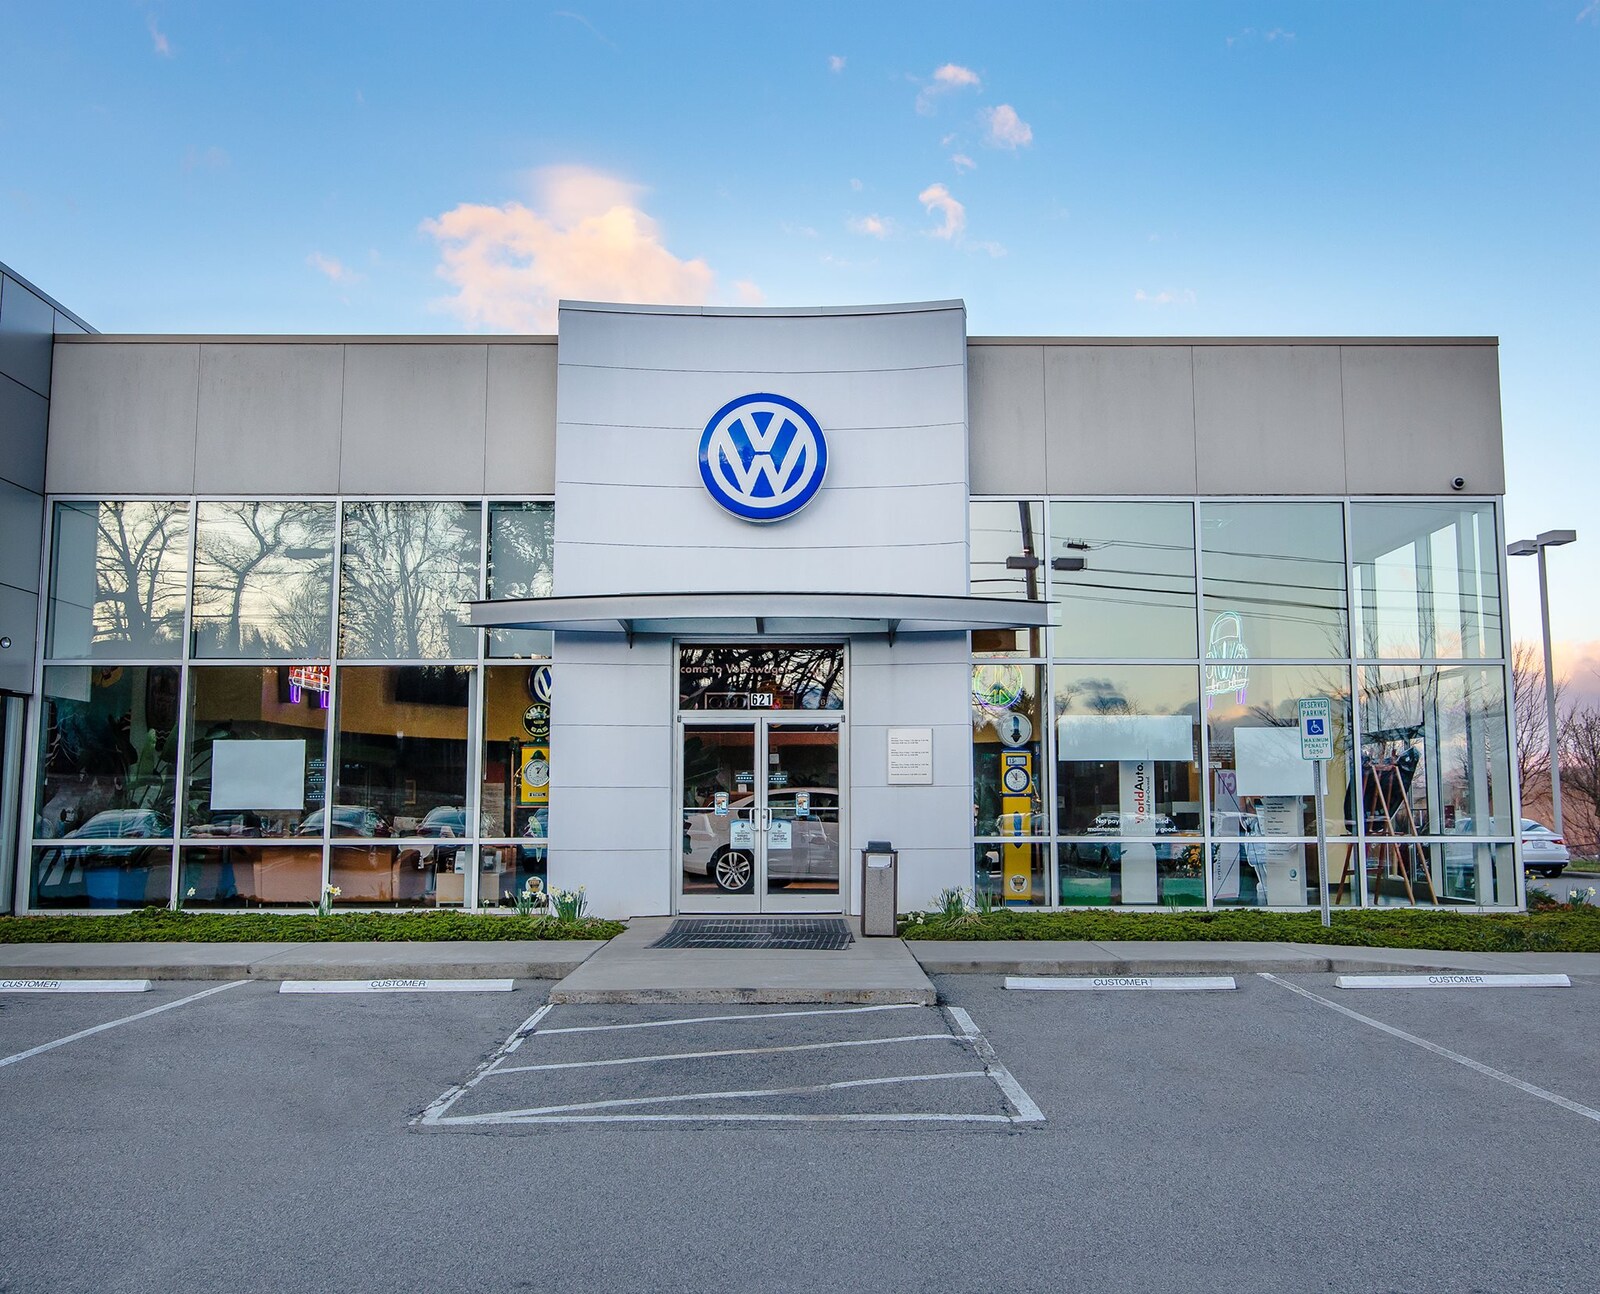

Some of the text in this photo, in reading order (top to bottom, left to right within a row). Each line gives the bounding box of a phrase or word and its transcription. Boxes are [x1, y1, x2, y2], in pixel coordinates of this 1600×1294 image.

[706, 400, 820, 510] VW
[751, 694, 772, 706] 621
[1300, 701, 1327, 709] RESERVED
[525, 705, 550, 720] POLL
[1302, 709, 1327, 717] PARKING
[530, 726, 549, 734] GAS
[1093, 978, 1149, 986] CUSTOMER
[1428, 975, 1484, 983] CUSTOMER
[2, 980, 59, 988] CUSTOMER
[370, 980, 426, 988] CUSTOMER
